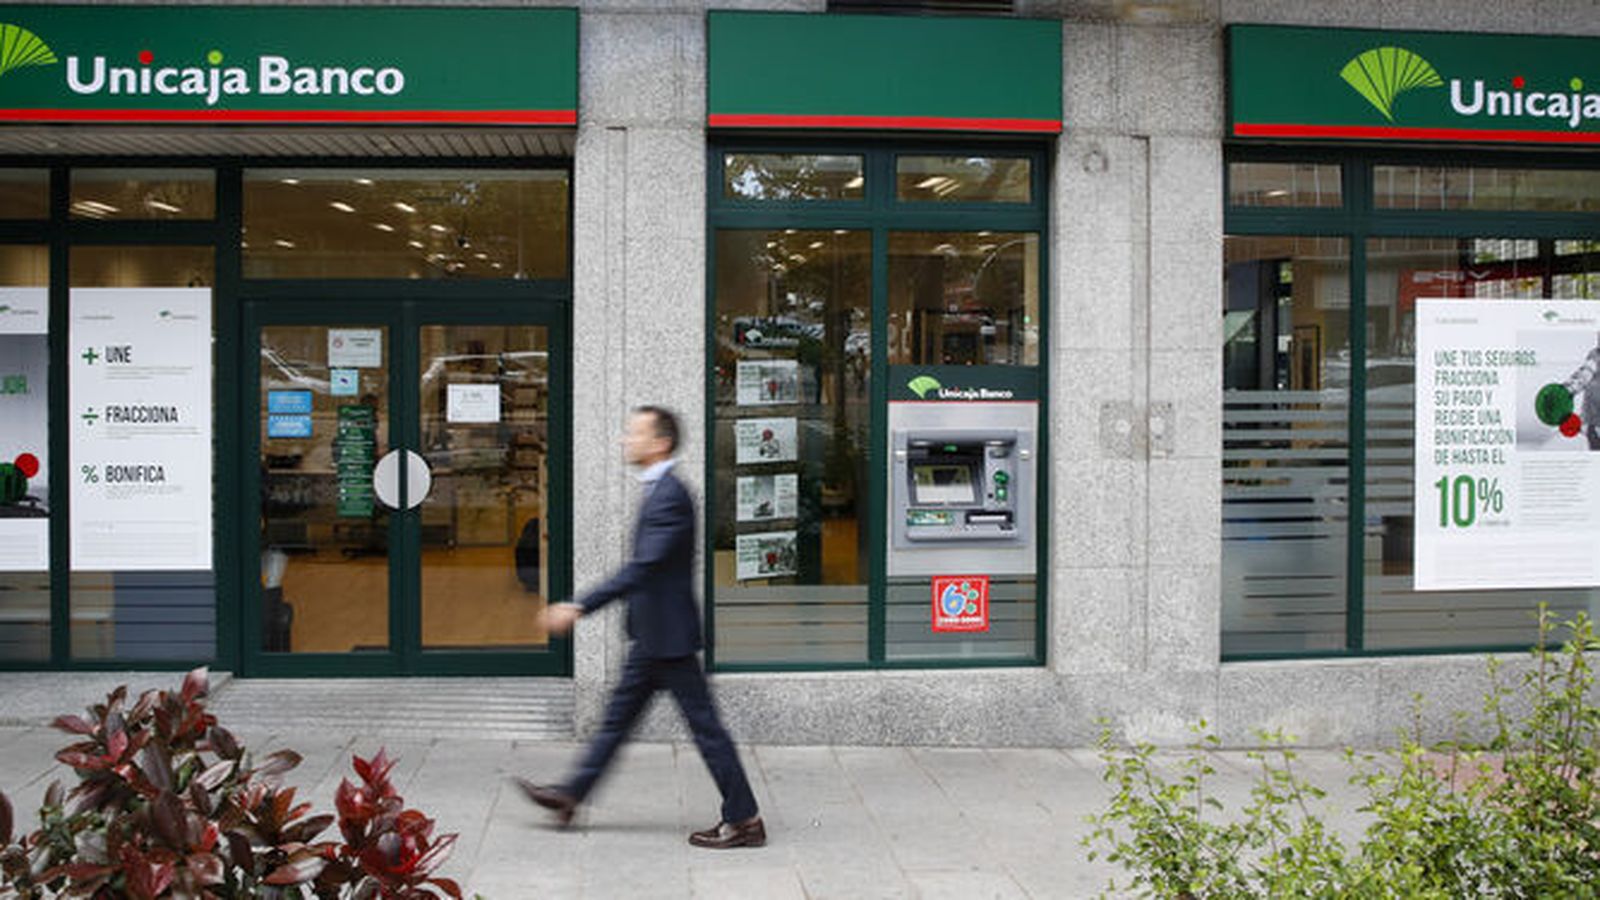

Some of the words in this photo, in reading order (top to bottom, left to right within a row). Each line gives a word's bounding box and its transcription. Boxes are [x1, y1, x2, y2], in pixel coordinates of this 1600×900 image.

[66, 50, 249, 104] Unicaja
[259, 56, 405, 95] Banco
[1450, 76, 1600, 128] Unicaja
[105, 346, 132, 364] UNE
[1435, 350, 1457, 367] UNE
[1461, 350, 1482, 367] TUS
[1435, 370, 1499, 386] FRACCIONA
[938, 386, 978, 399] Unicaja
[980, 389, 1013, 398] Banco
[1435, 390, 1450, 406] SU
[1453, 390, 1483, 406] PAGO
[1485, 390, 1493, 405] Y
[105, 406, 178, 423] FRACCIONA
[1435, 409, 1475, 425] RECIBE
[1478, 409, 1502, 425] UNA
[1435, 448, 1448, 465] DE
[1452, 448, 1490, 465] HASTA
[1492, 448, 1506, 464] EL
[105, 465, 165, 483] BONIFICA
